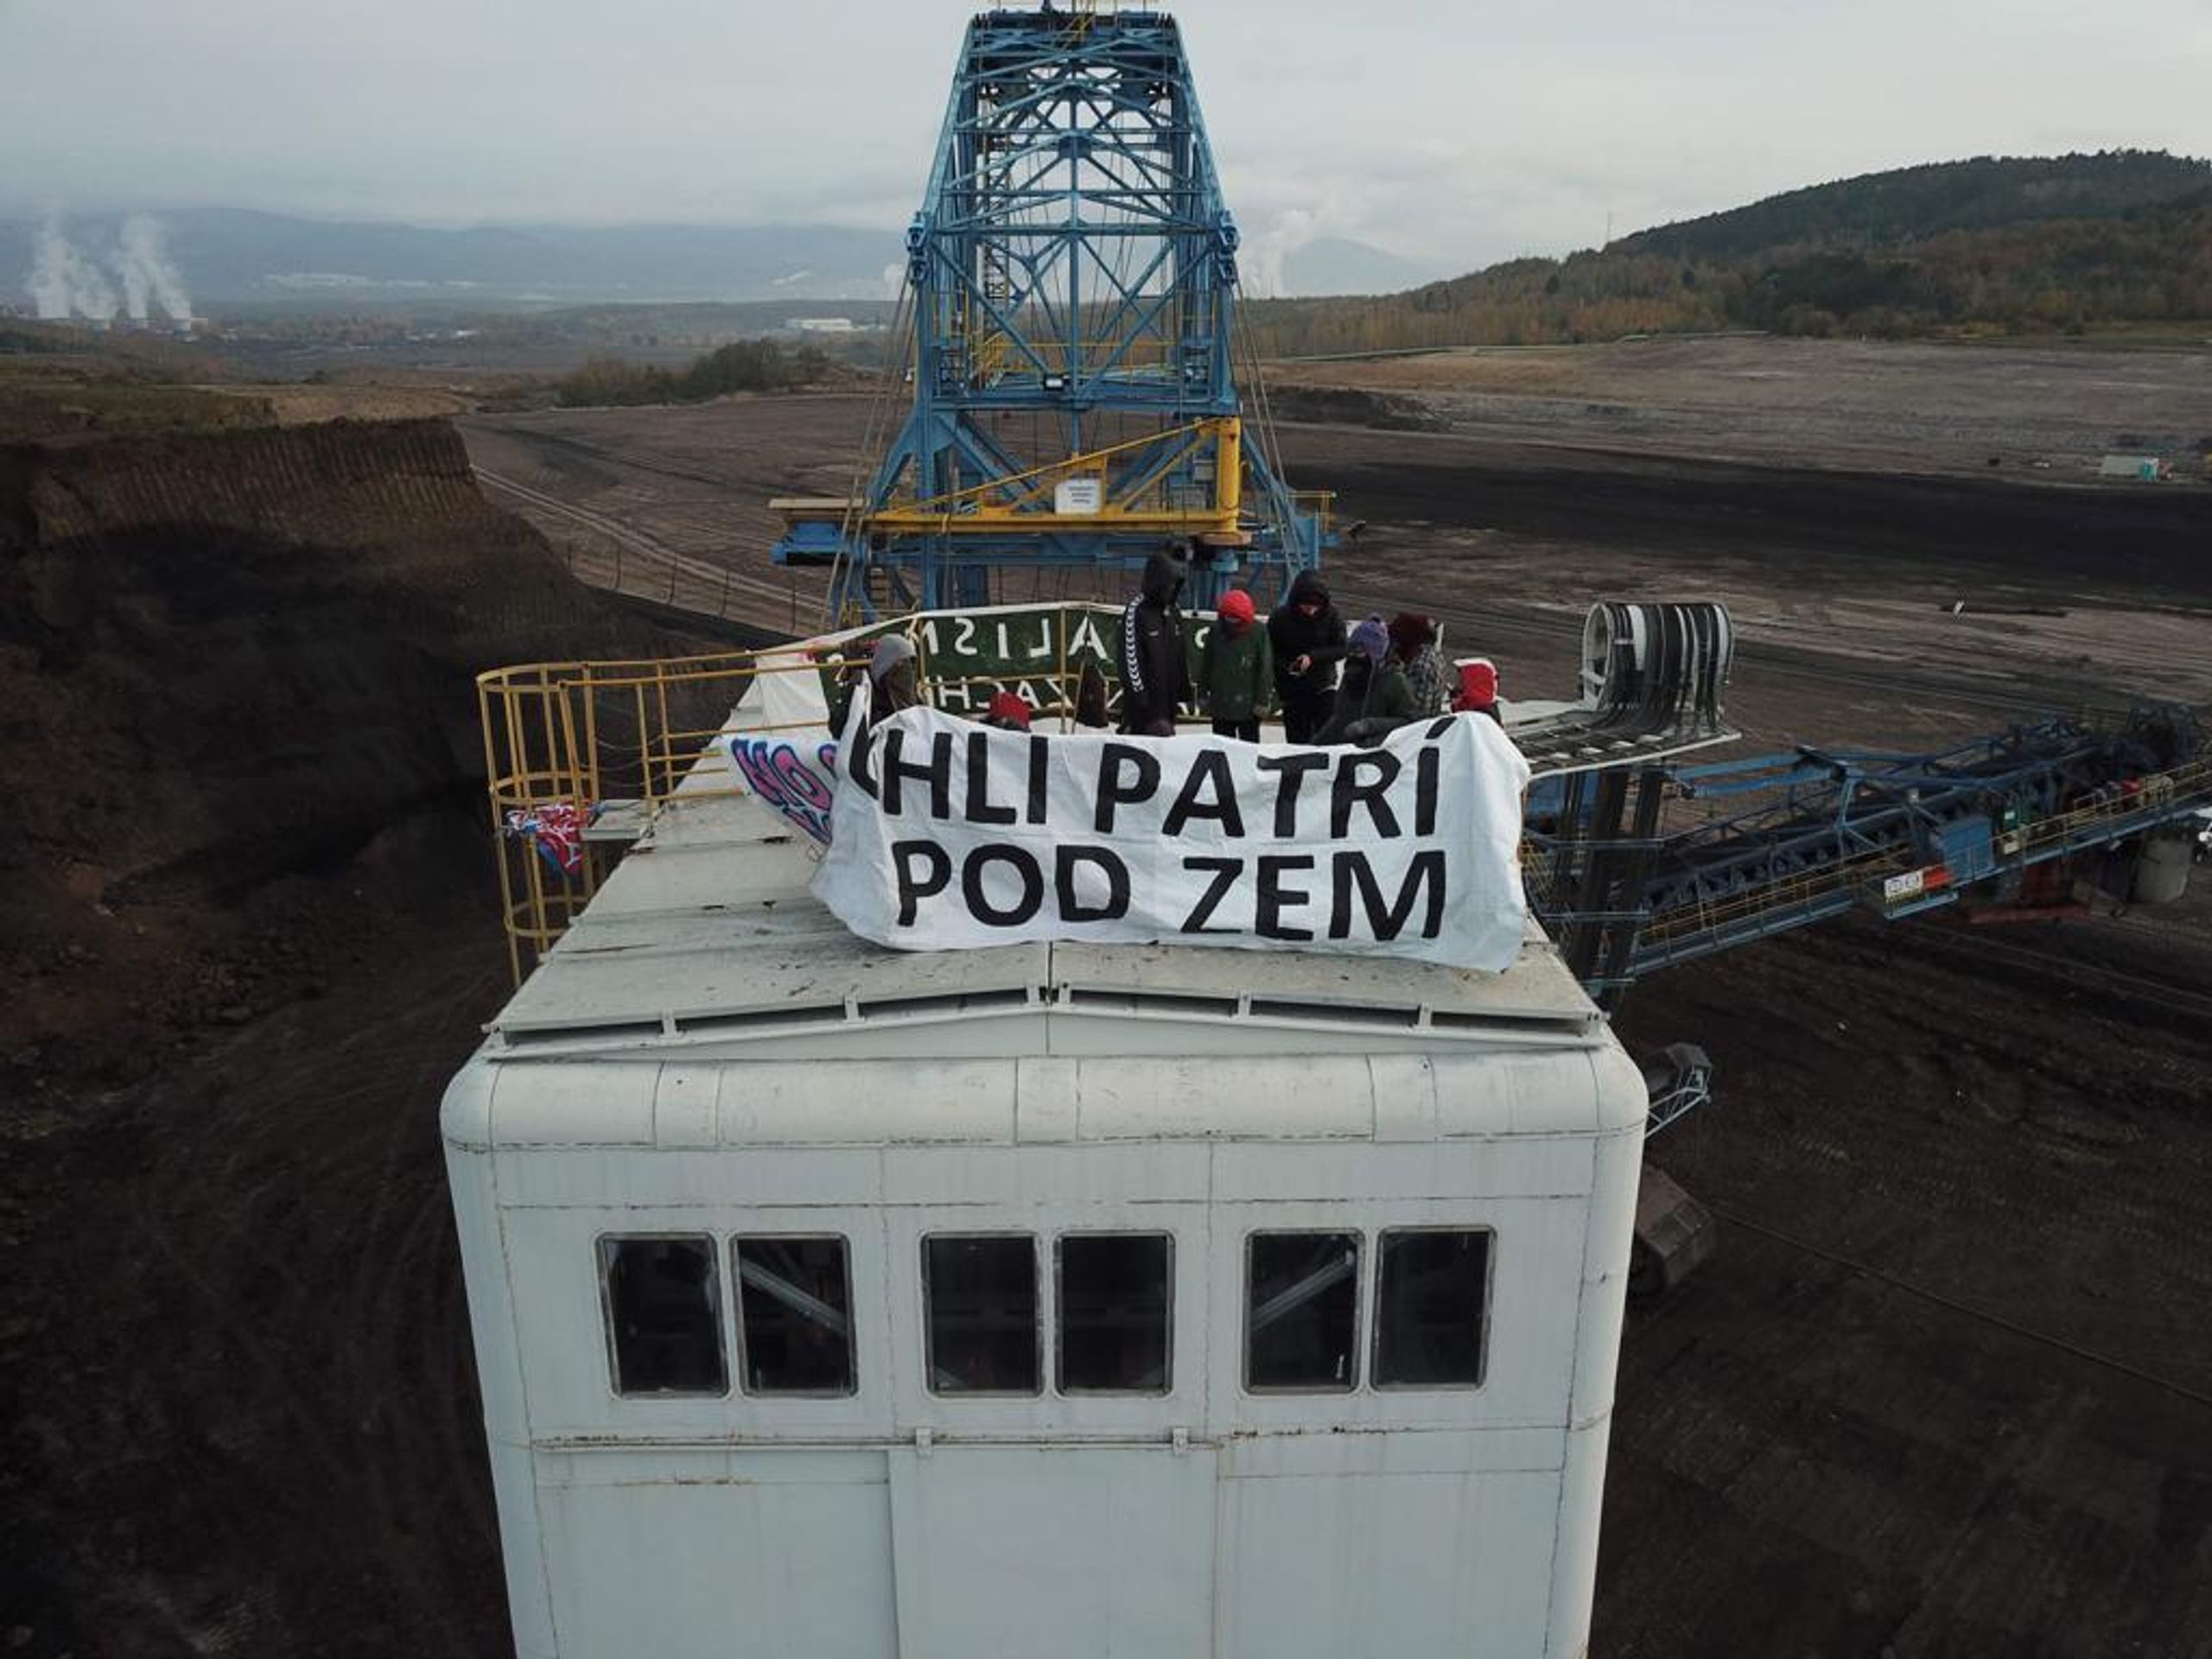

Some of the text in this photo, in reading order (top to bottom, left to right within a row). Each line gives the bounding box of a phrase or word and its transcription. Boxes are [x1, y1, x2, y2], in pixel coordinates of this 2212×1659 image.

[1095, 717, 1456, 838] PATRÍ
[892, 840, 1446, 942] POD ZEM
